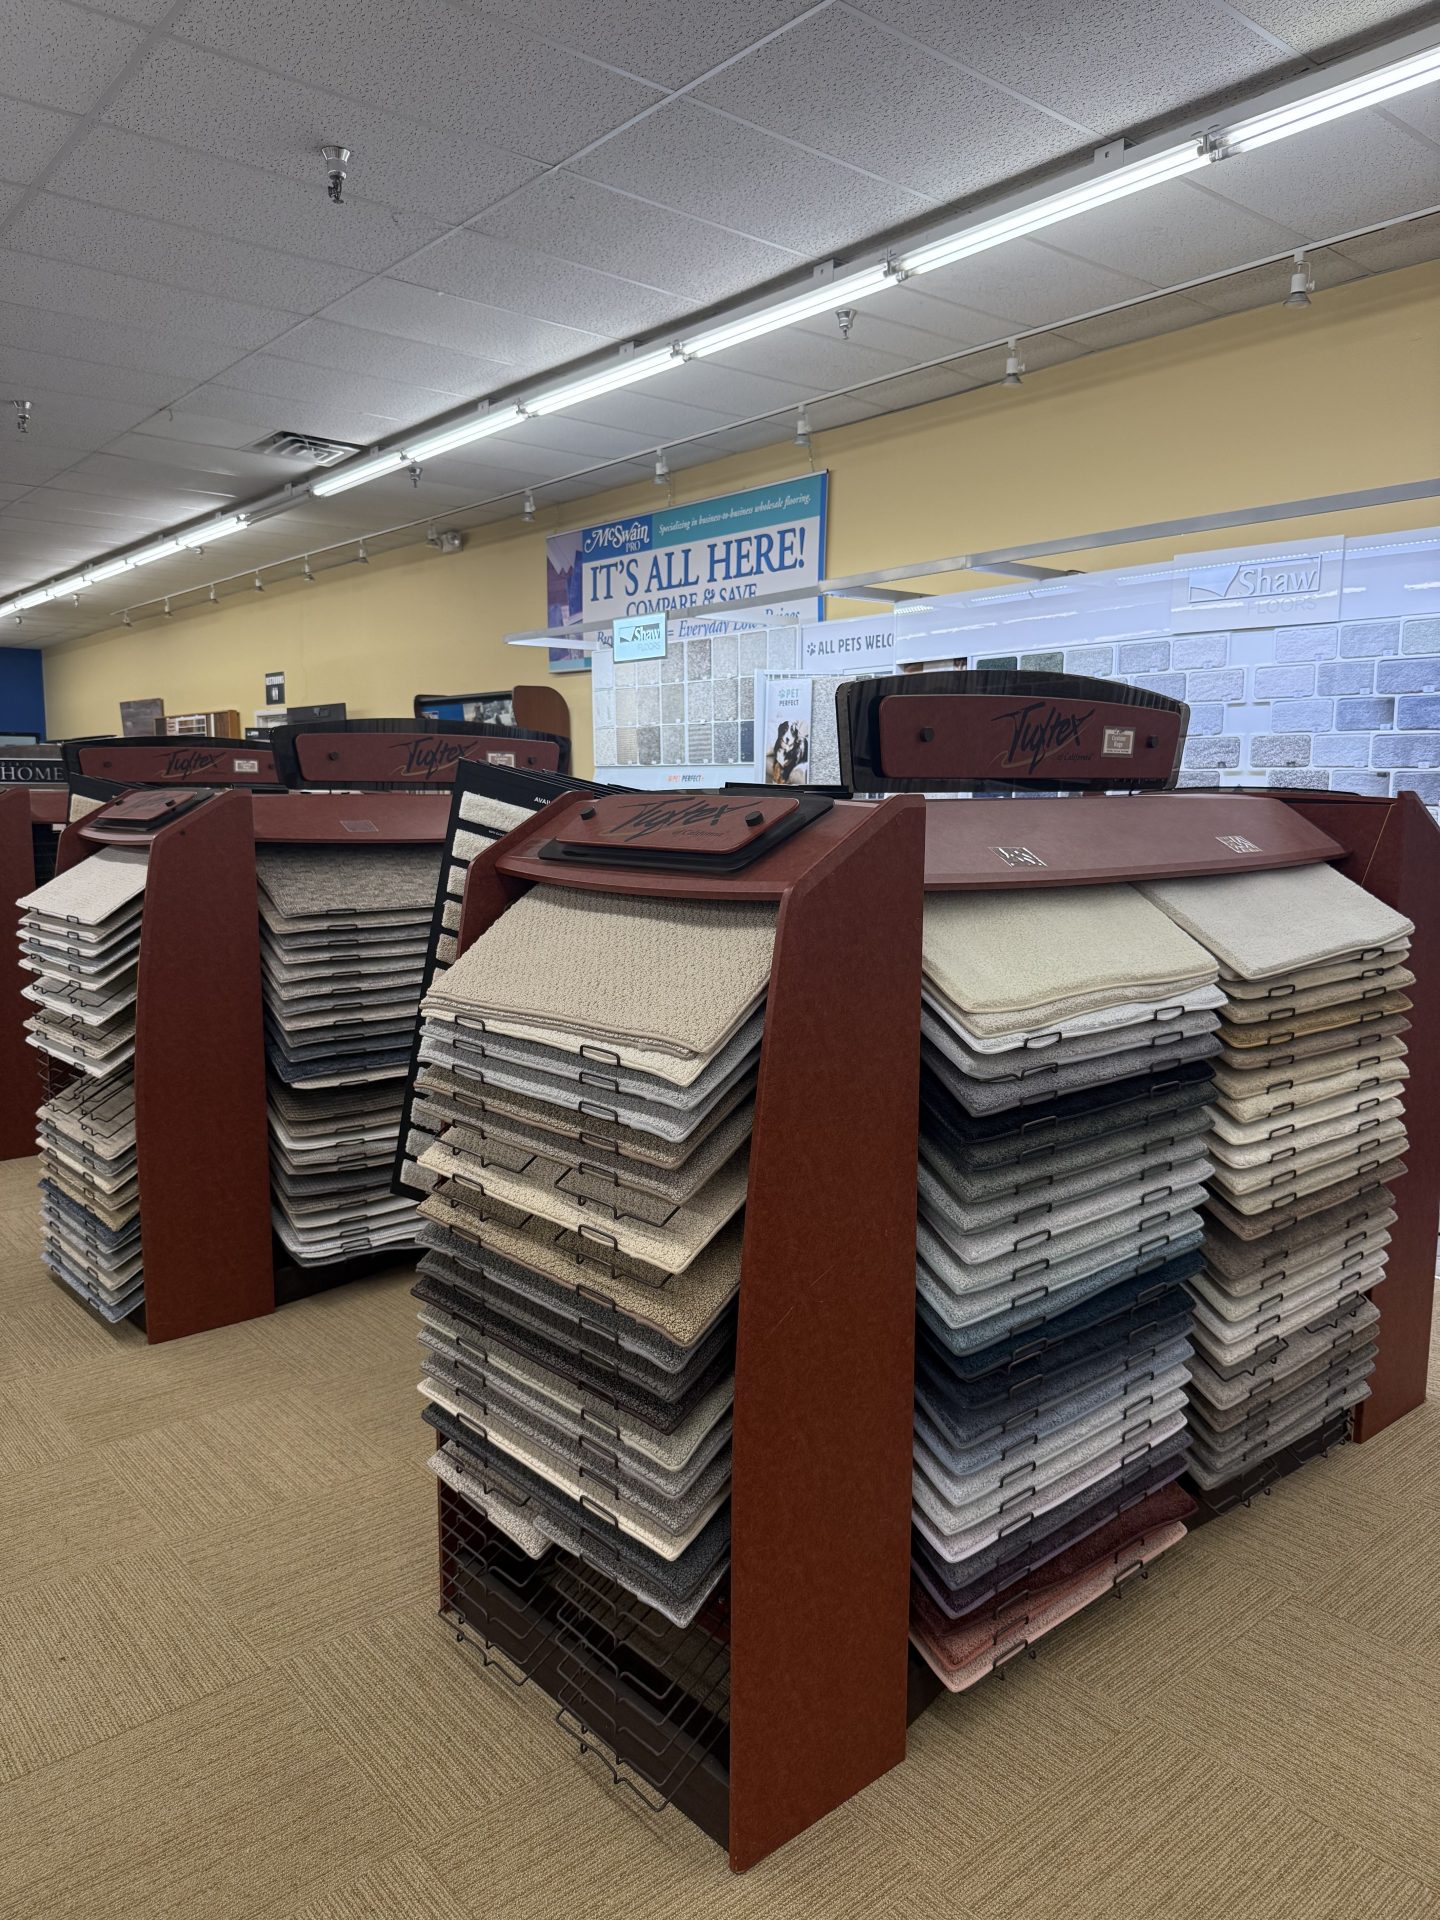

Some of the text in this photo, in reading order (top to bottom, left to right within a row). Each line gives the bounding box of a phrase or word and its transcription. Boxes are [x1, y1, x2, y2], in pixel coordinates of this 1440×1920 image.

[658, 518, 691, 536] Specializing
[754, 498, 783, 514] wholesale
[584, 521, 650, 554] McSwain
[625, 541, 642, 553] PRO
[590, 526, 806, 602] IT'S ALL HERE!
[1240, 567, 1317, 596] Shaw
[703, 588, 716, 607] &
[1247, 599, 1317, 615] FLOORS
[634, 624, 661, 643] Shaw
[679, 619, 729, 637] Everyday
[818, 640, 835, 655] ALL
[838, 637, 862, 653] PETS
[786, 689, 799, 698] PET
[779, 699, 799, 707] PERFECT
[991, 702, 1095, 775] Tuftex
[0, 766, 65, 781] HOME
